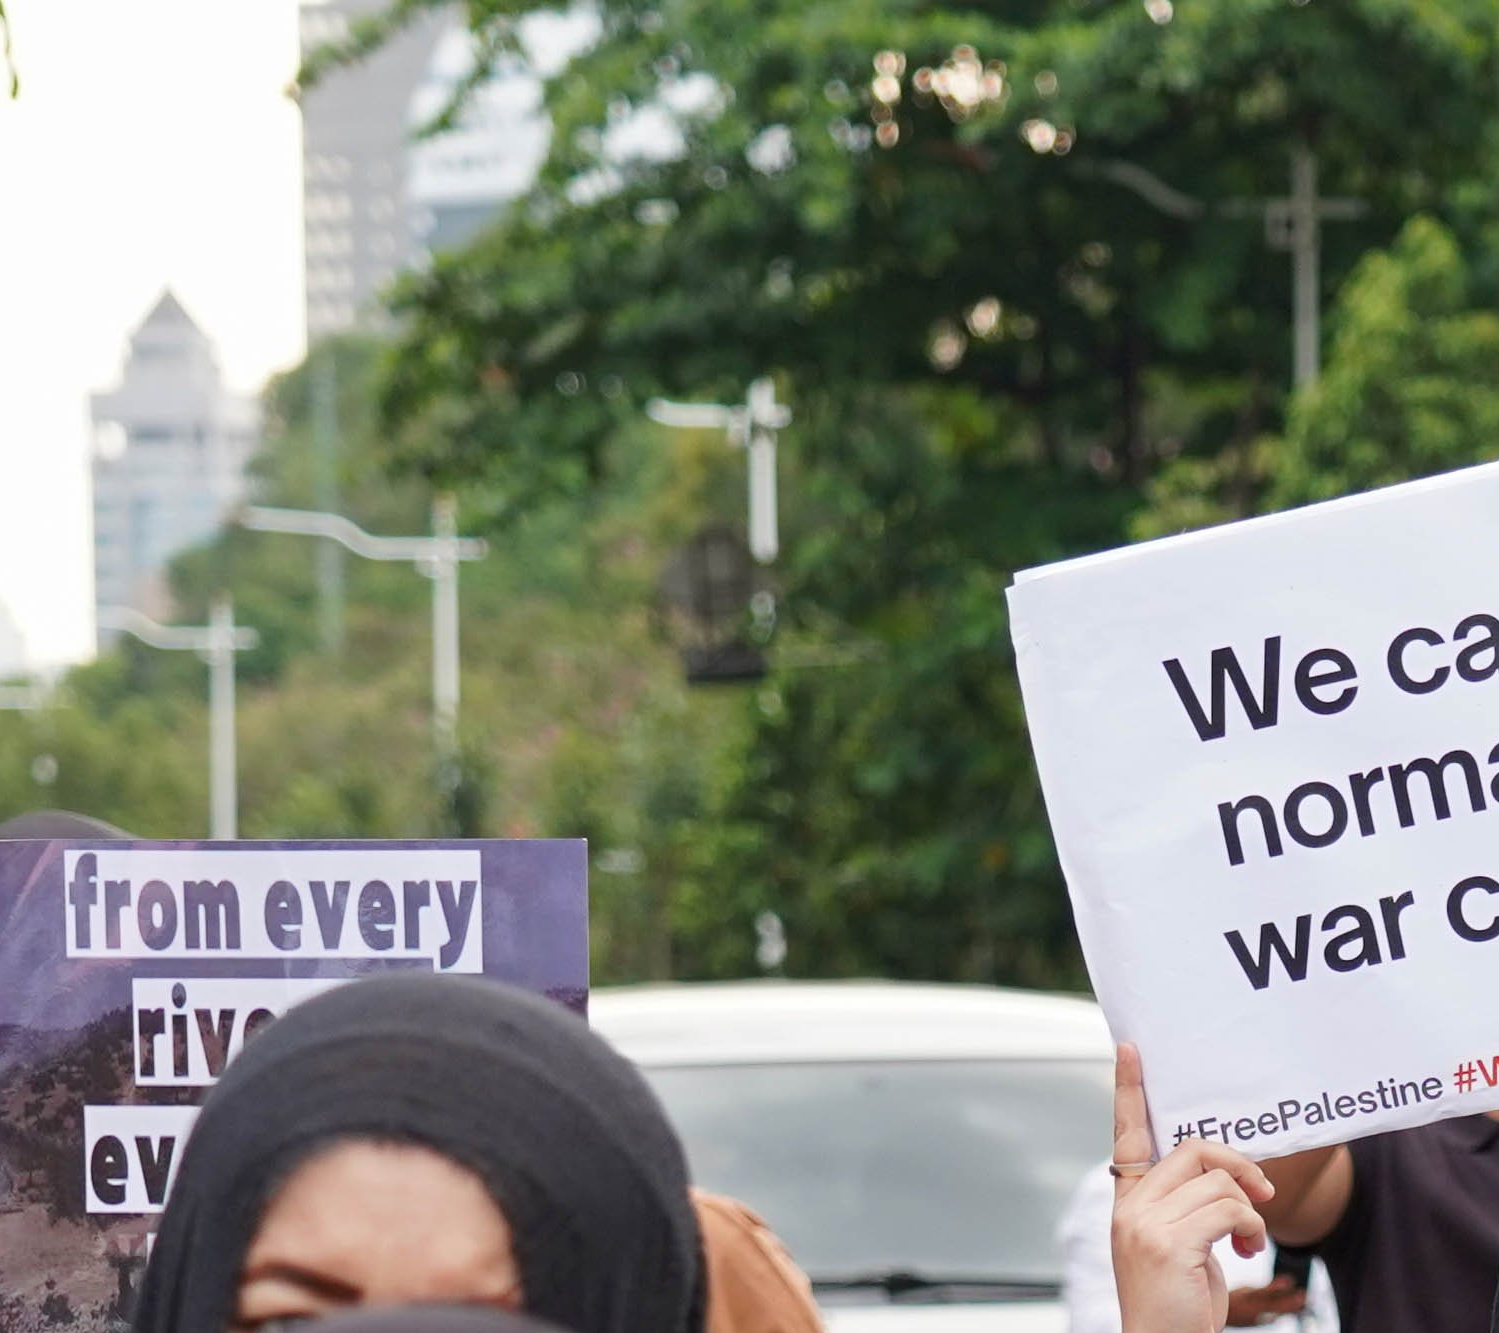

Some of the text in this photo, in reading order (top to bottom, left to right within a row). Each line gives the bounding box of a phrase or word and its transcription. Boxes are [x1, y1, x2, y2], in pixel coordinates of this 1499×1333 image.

[1162, 635, 1359, 742] We
[68, 853, 477, 969] from every
[1224, 888, 1415, 990] war
[1173, 1068, 1443, 1146] #FreePalestine
